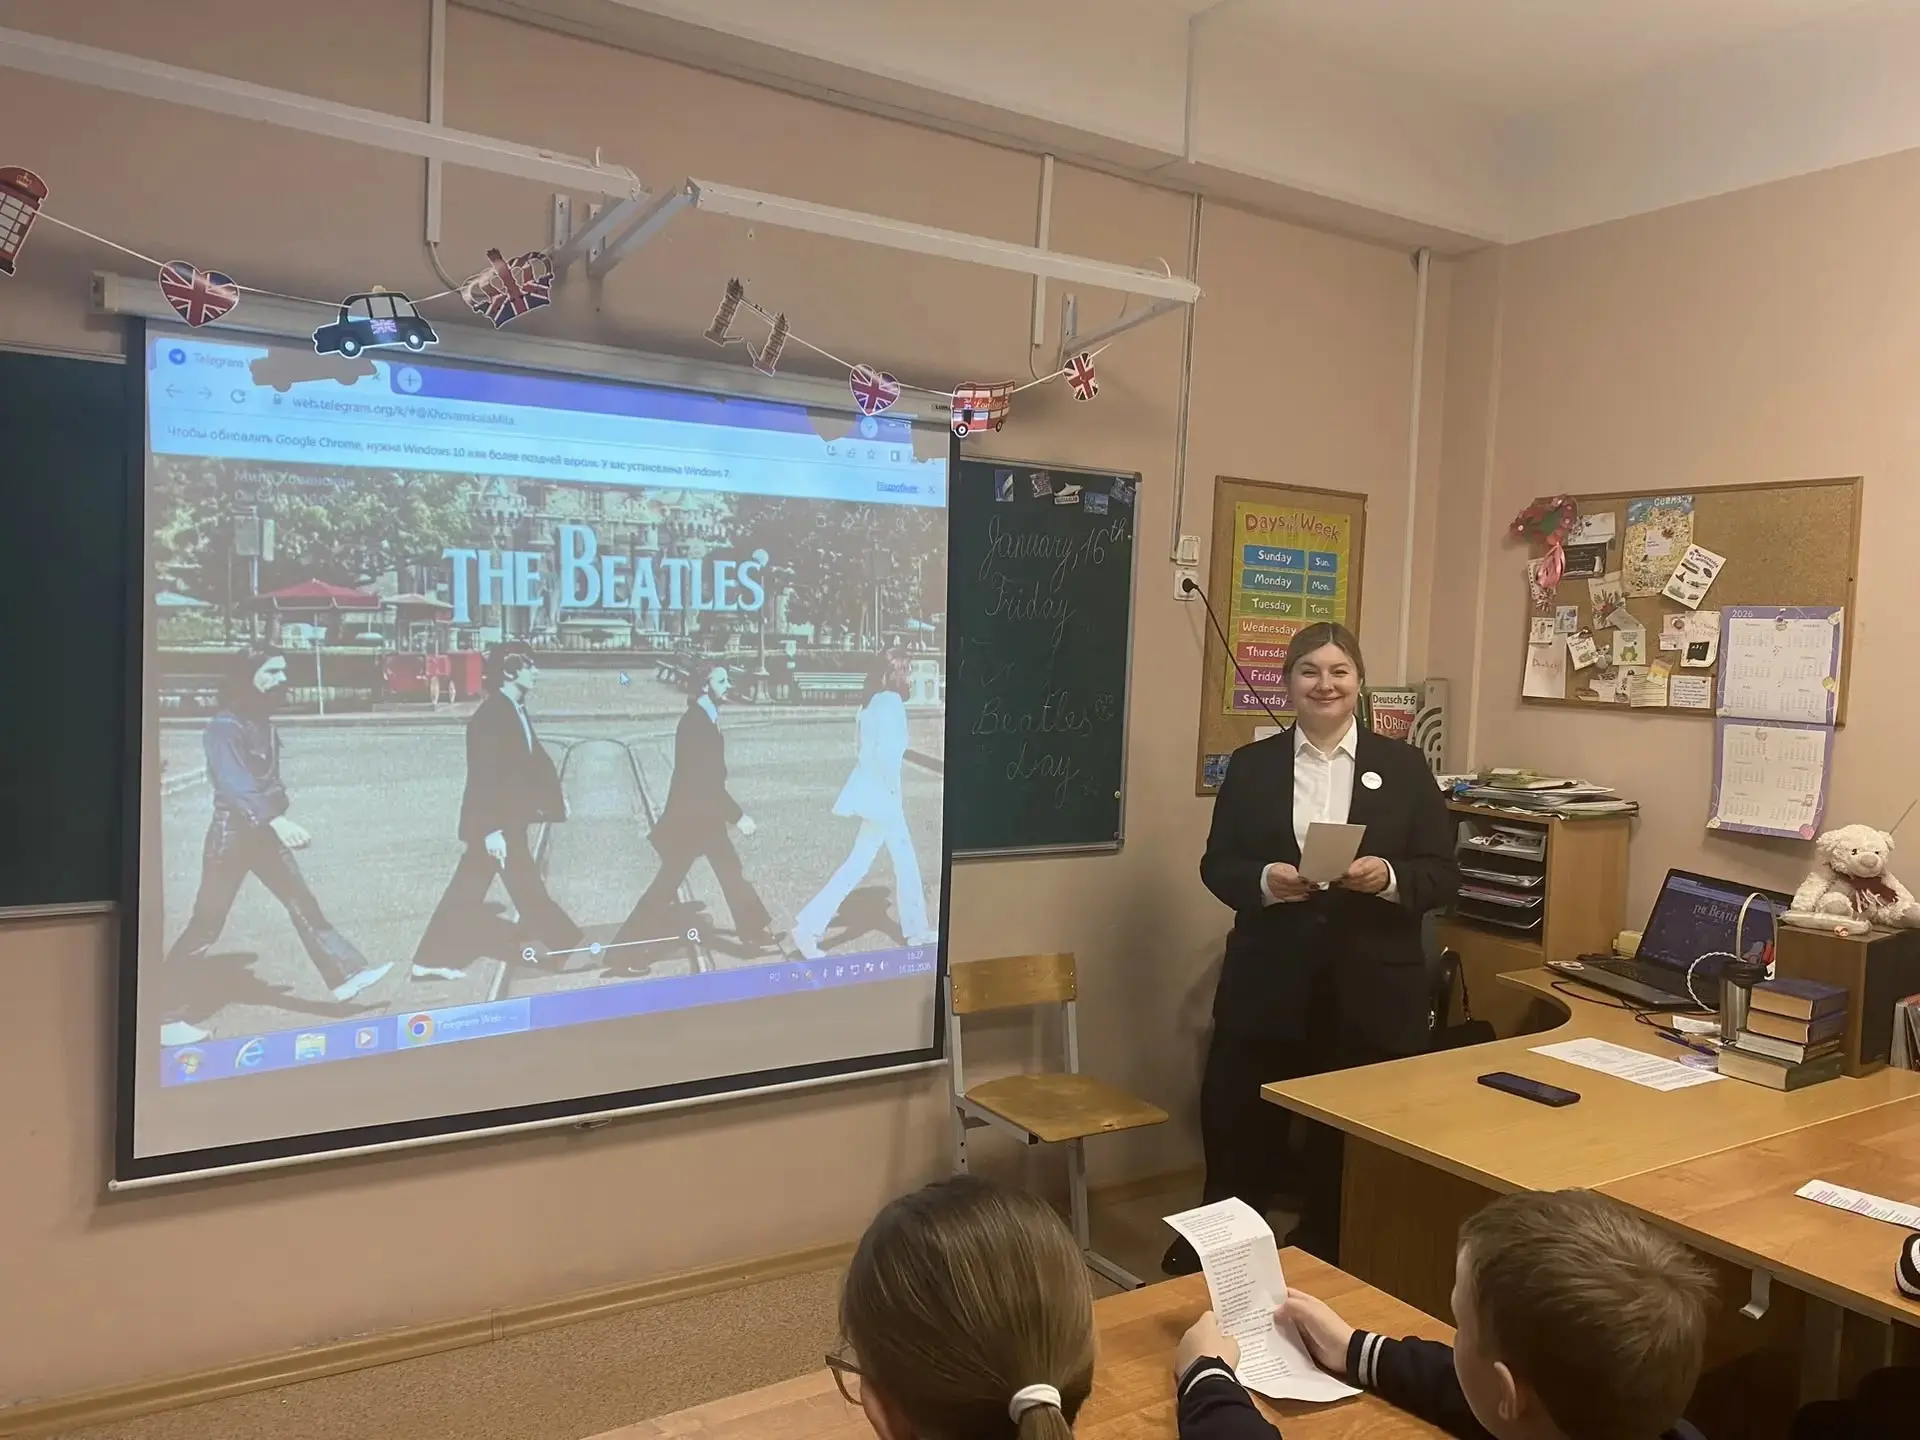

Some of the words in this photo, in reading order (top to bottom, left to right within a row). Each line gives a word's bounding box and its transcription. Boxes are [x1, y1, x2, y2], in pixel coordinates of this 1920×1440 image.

[192, 352, 244, 368] Telegram
[275, 434, 317, 449] Google
[402, 443, 451, 456] Windows
[452, 447, 465, 458] 10
[489, 449, 519, 461] более
[683, 466, 723, 478] Windows
[1245, 513, 1285, 532] Days
[1301, 512, 1340, 541] Week
[1258, 550, 1292, 564] Sunday
[1315, 557, 1330, 567] Sun.
[442, 547, 544, 624] THE
[1254, 574, 1292, 589] Monday
[984, 571, 1076, 656] Friday
[1251, 598, 1292, 612] Tuesday
[1732, 610, 1753, 618] 2026
[1242, 621, 1297, 637] Wednesday
[1251, 670, 1282, 684] Friday
[1373, 694, 1402, 704] Deutsch
[1403, 696, 1416, 705] 5-6
[972, 682, 1092, 738] Beatles
[1373, 710, 1410, 733] HORIZO
[1709, 904, 1737, 922] BEATLE
